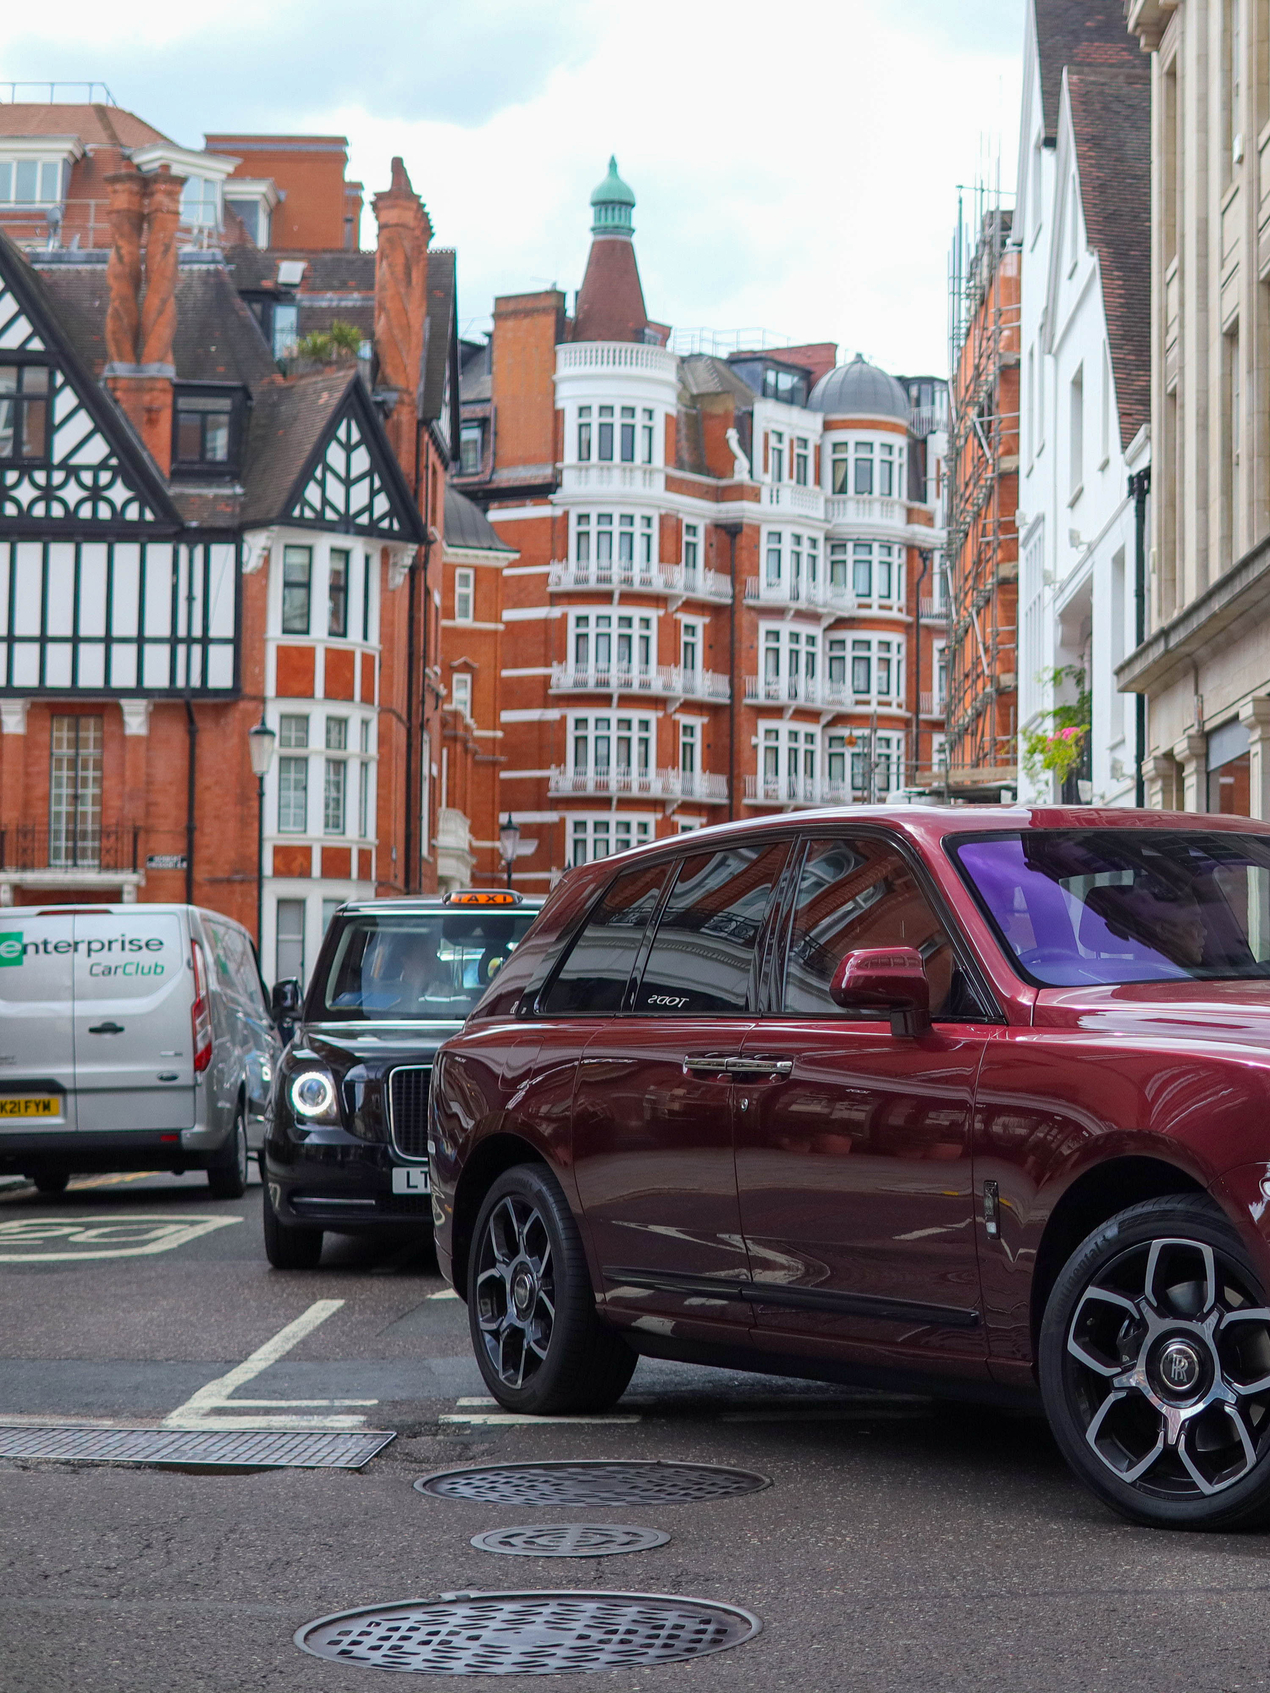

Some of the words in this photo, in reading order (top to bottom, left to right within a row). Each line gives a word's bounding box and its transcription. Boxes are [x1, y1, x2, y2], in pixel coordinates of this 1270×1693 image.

[0, 933, 164, 958] enterprise
[89, 962, 165, 977] CarClub
[25, 1100, 52, 1113] FYM
